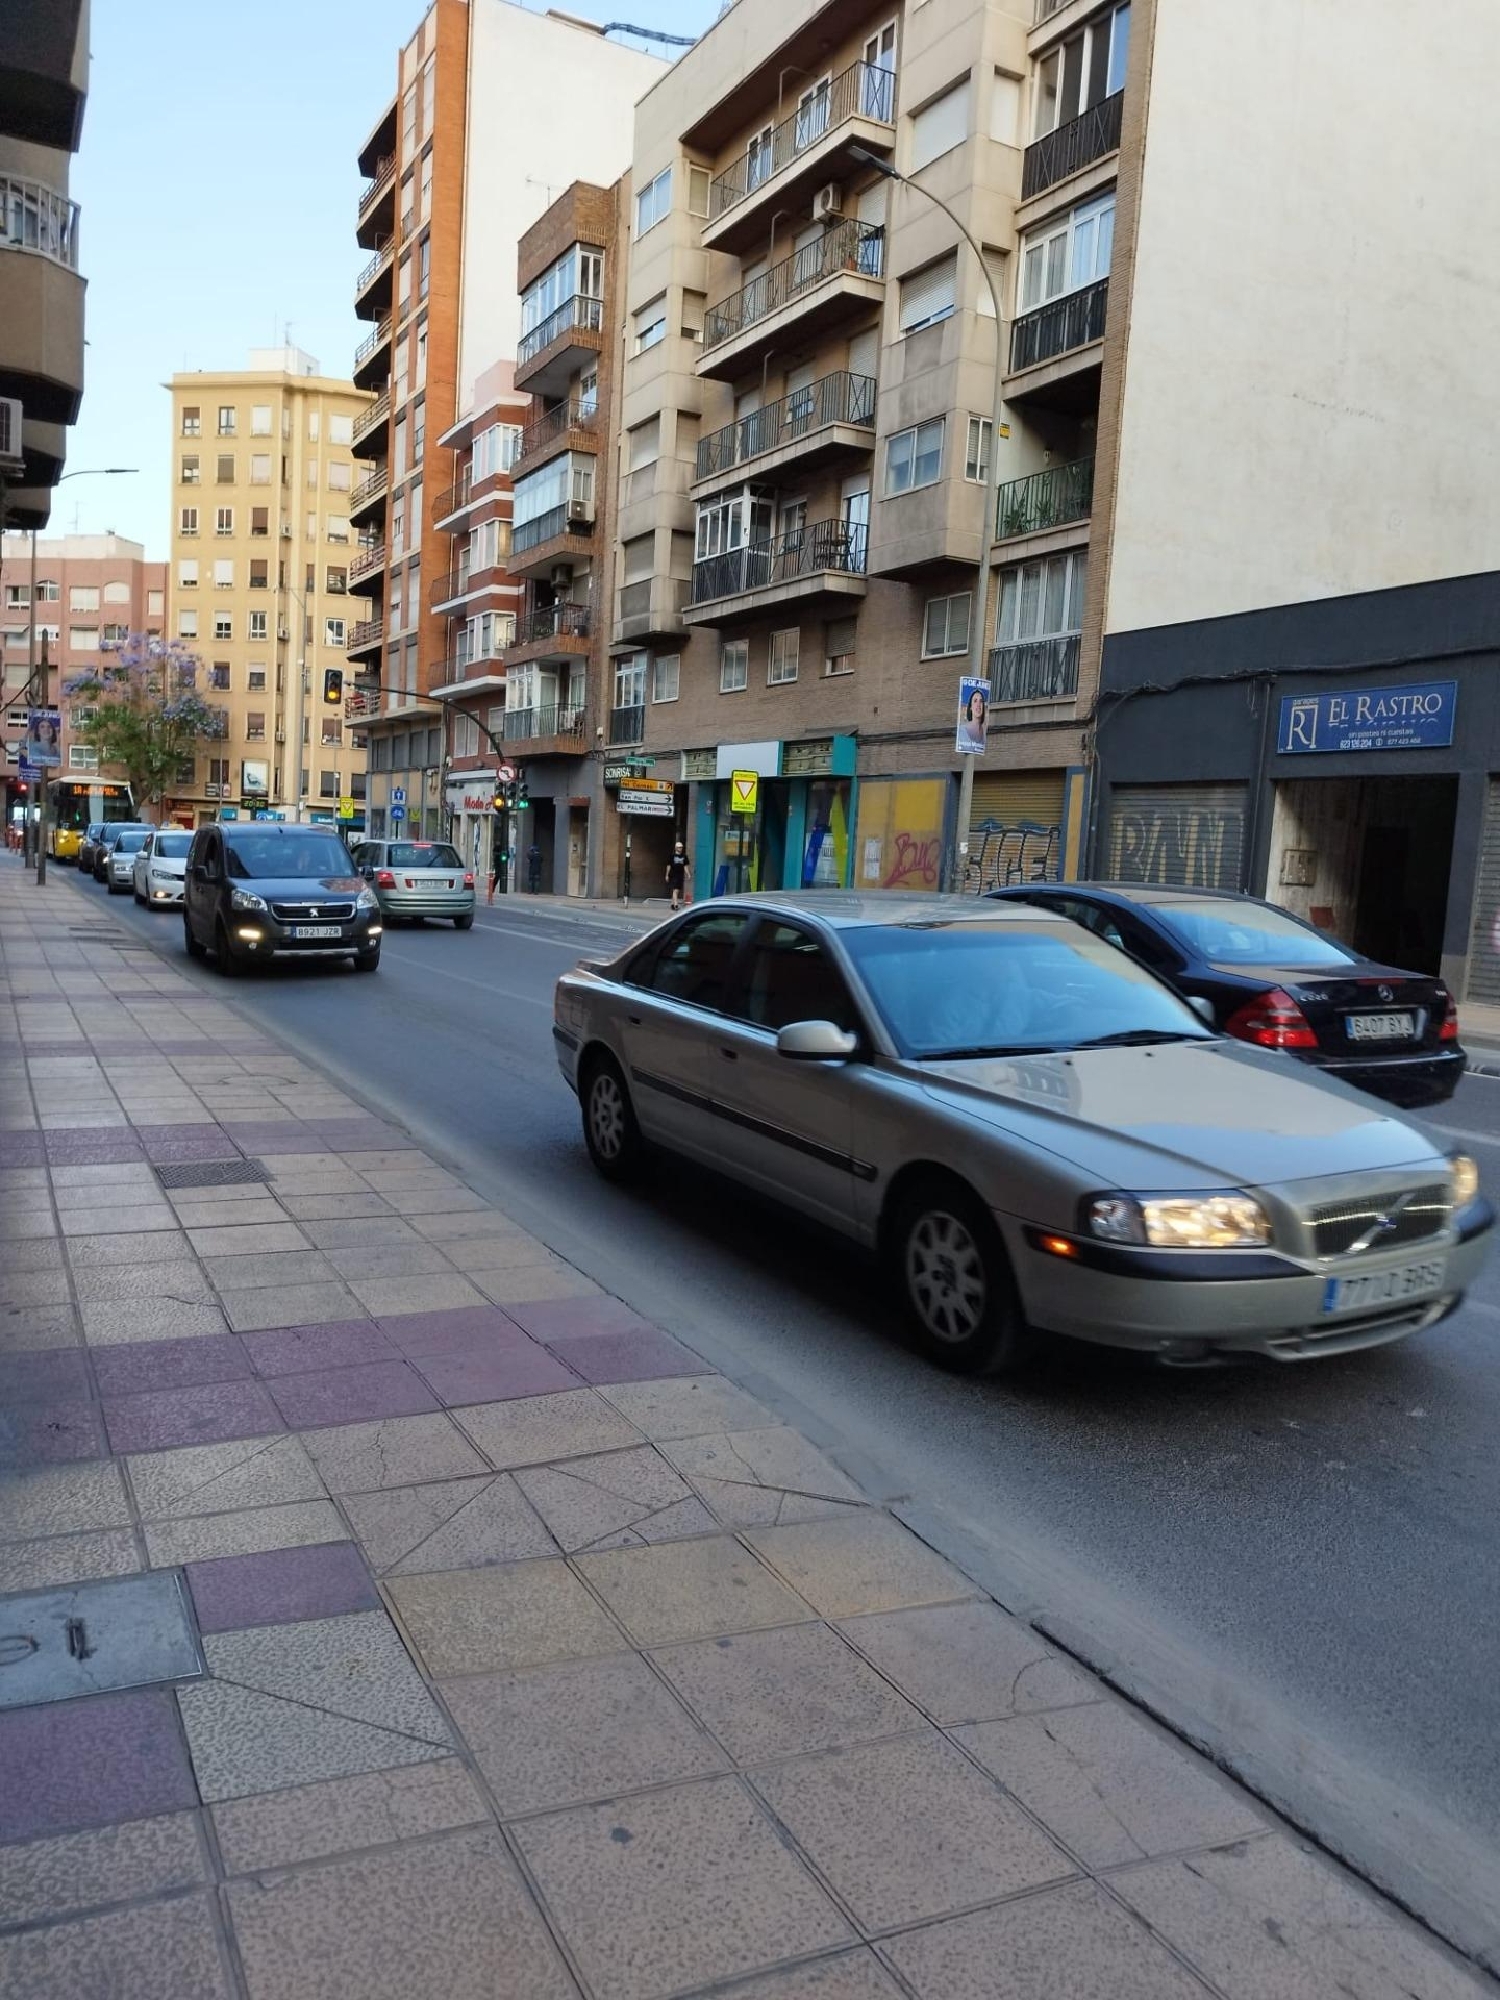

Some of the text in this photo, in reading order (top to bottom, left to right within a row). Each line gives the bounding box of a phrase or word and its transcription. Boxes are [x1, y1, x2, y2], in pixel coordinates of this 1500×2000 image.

[1355, 693, 1442, 721] RASTRO
[298, 926, 340, 936] 8921 JZR
